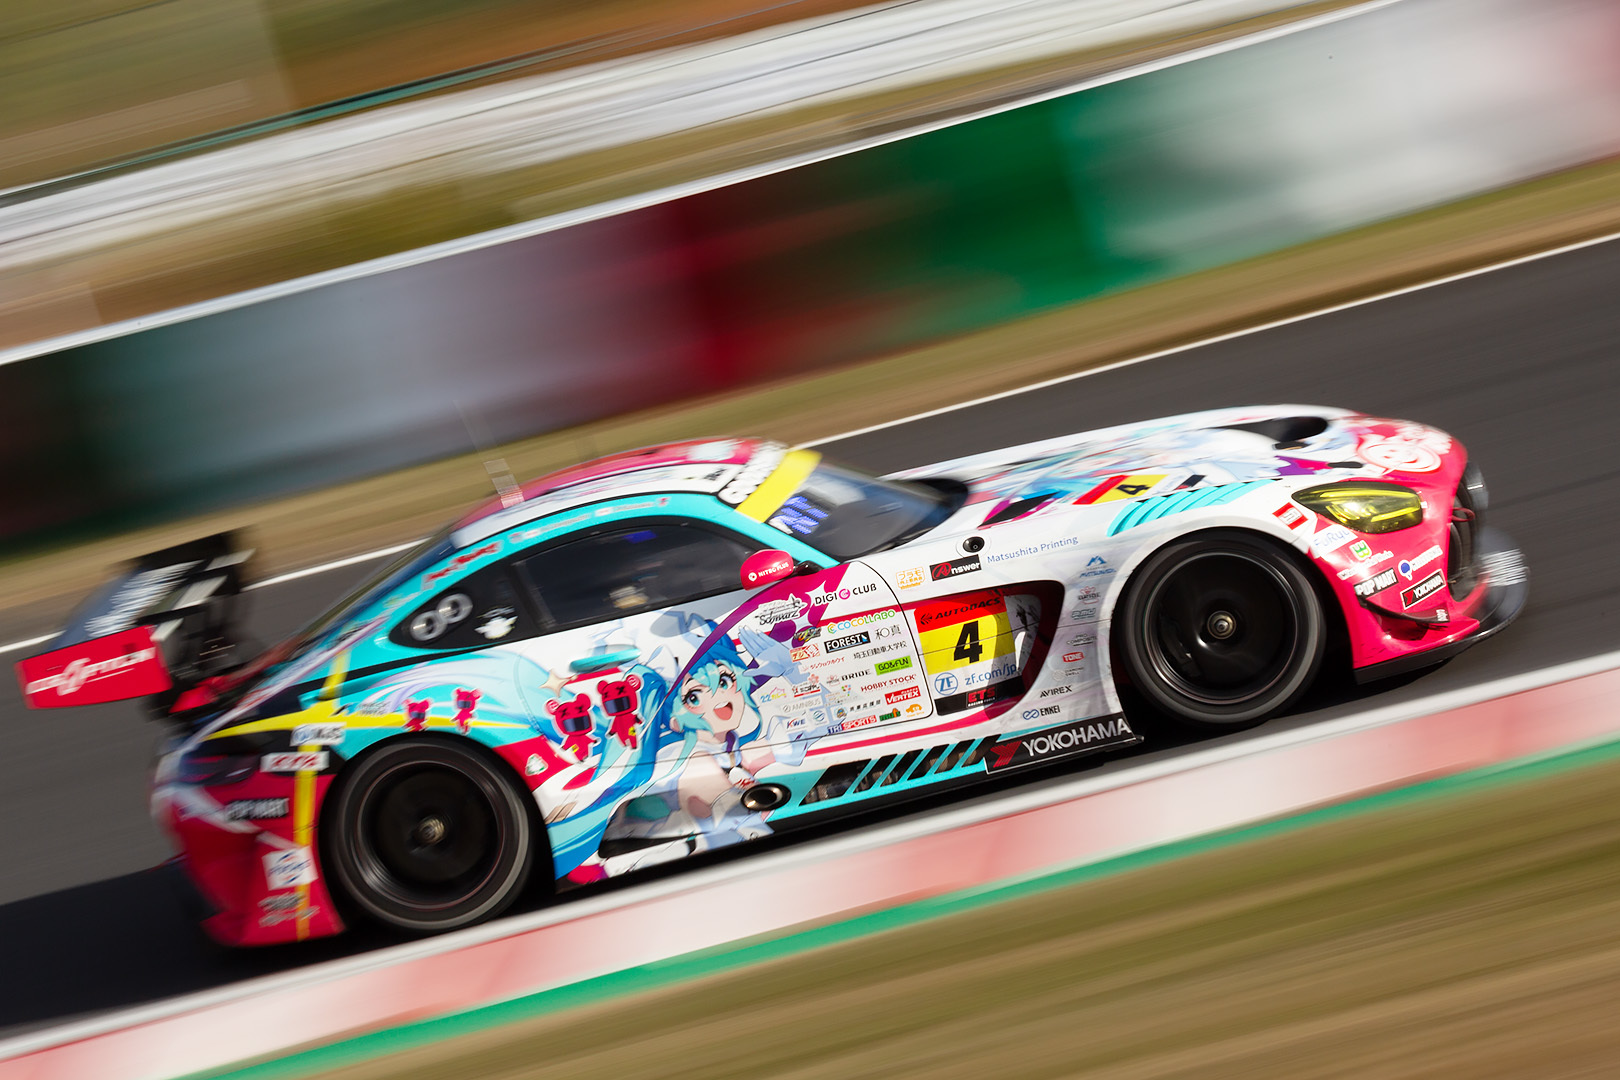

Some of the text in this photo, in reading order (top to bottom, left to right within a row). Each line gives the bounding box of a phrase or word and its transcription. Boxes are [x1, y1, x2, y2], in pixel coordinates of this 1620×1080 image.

[987, 537, 1079, 564] Matsushita Printing
[758, 567, 777, 577] NITRO
[814, 583, 877, 605] DIGI CLUB
[935, 597, 1001, 620] AUTOBACS
[837, 609, 896, 631] COCOLLABO
[826, 634, 862, 651] FOREST
[953, 620, 983, 664] 4
[877, 657, 909, 671] GO&FUN
[1063, 652, 1083, 662] TONE
[841, 669, 871, 681] BRIDE
[860, 681, 888, 692] HOBBY
[888, 674, 915, 686] STOCK
[964, 663, 1017, 686] zf.com/jp
[935, 673, 958, 694] ZF
[1039, 685, 1073, 698] AVIREX
[886, 690, 920, 704] VERTEX
[968, 687, 996, 703] ETS
[1040, 705, 1061, 717] ENKEI
[842, 715, 876, 730] SPORTS
[1022, 718, 1132, 757] YOKOHAMA
